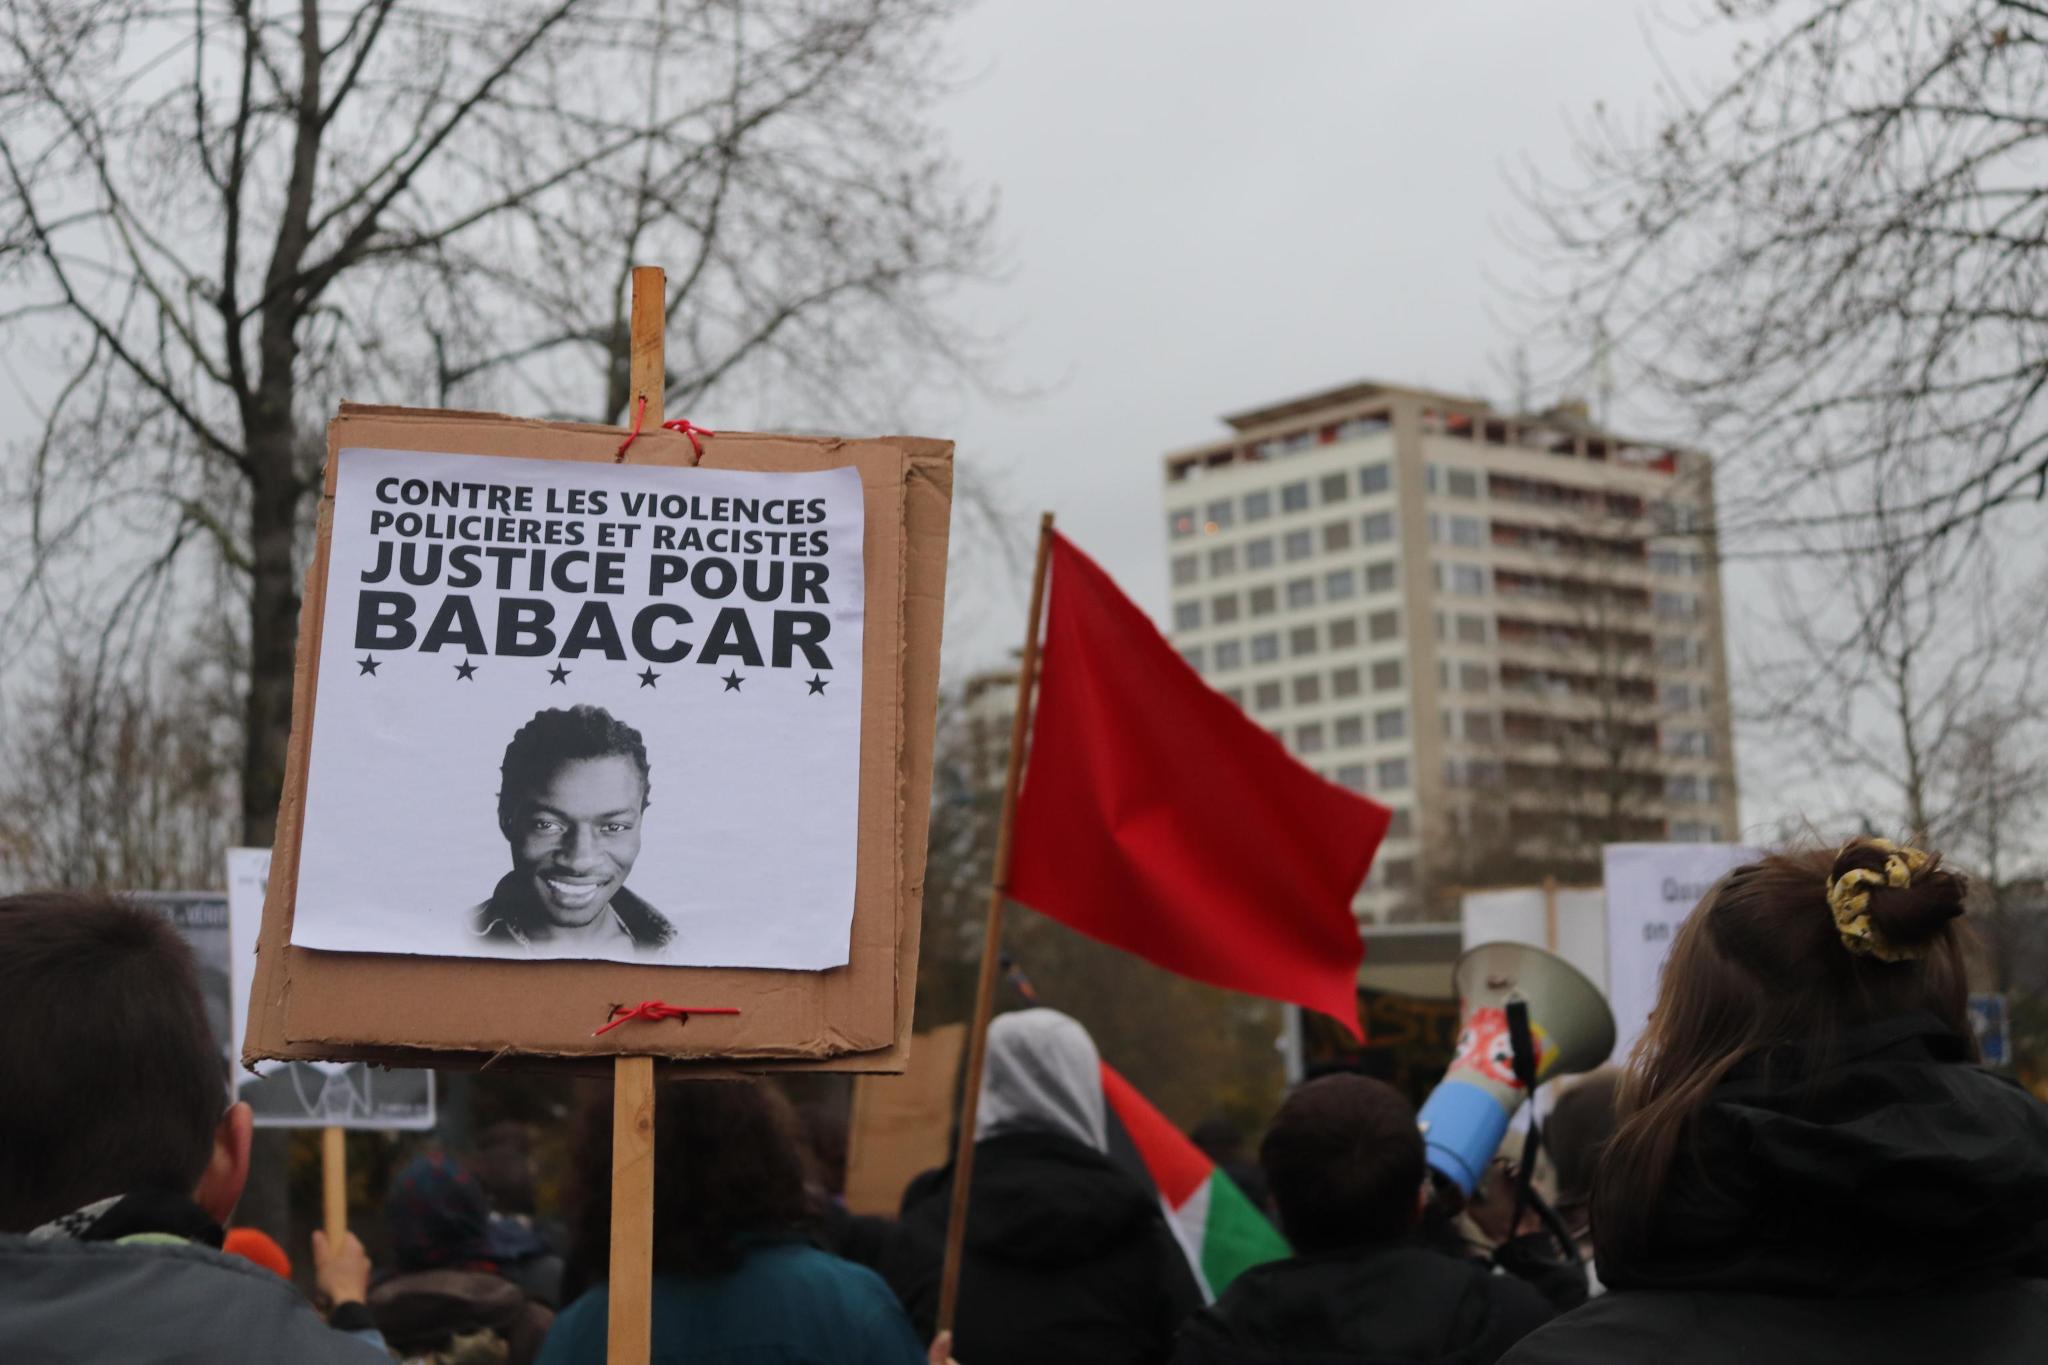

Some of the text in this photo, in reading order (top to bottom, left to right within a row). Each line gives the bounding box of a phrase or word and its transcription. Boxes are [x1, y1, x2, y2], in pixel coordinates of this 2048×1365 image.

[375, 477, 827, 525] CONTRE LES VIOLENCES
[370, 508, 829, 557] POLICIÈRES ET RACISTES
[360, 540, 830, 604] JUSTICE POUR
[354, 589, 834, 670] BABACAR
